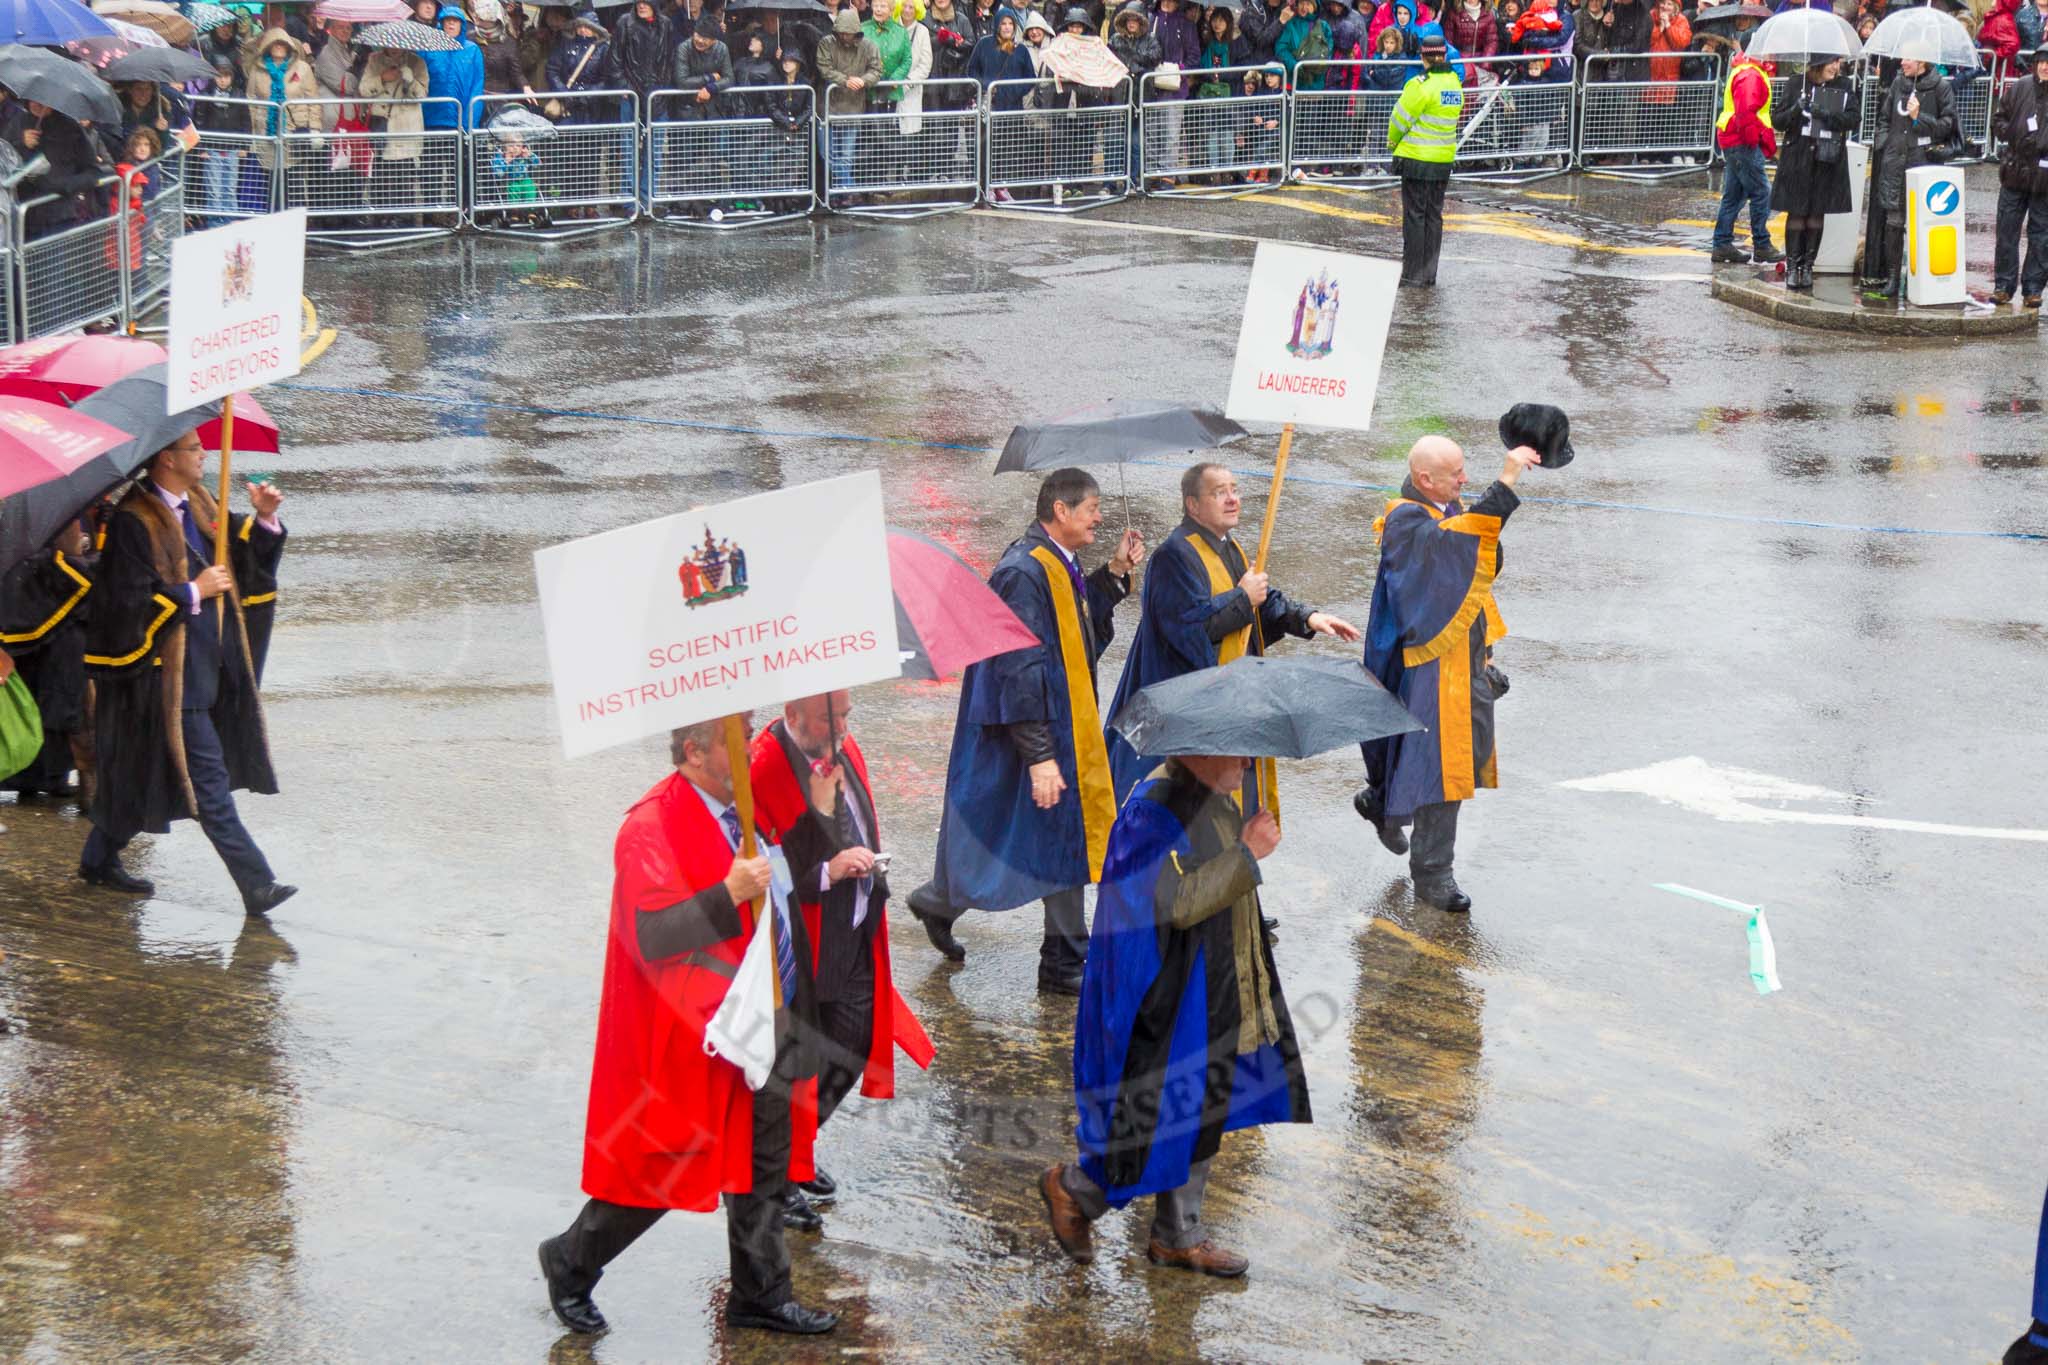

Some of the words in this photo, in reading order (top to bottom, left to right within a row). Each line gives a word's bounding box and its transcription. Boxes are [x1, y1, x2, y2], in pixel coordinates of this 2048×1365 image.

[1441, 95, 1462, 105] POLICE
[191, 314, 280, 360] CHARTERED
[189, 346, 281, 394] SURVEYORS
[1258, 370, 1347, 398] LAUNDERERS
[648, 614, 799, 669] SCIENTIFIC
[579, 656, 755, 722] INSTRUMENT
[763, 630, 878, 673] MAKERS
